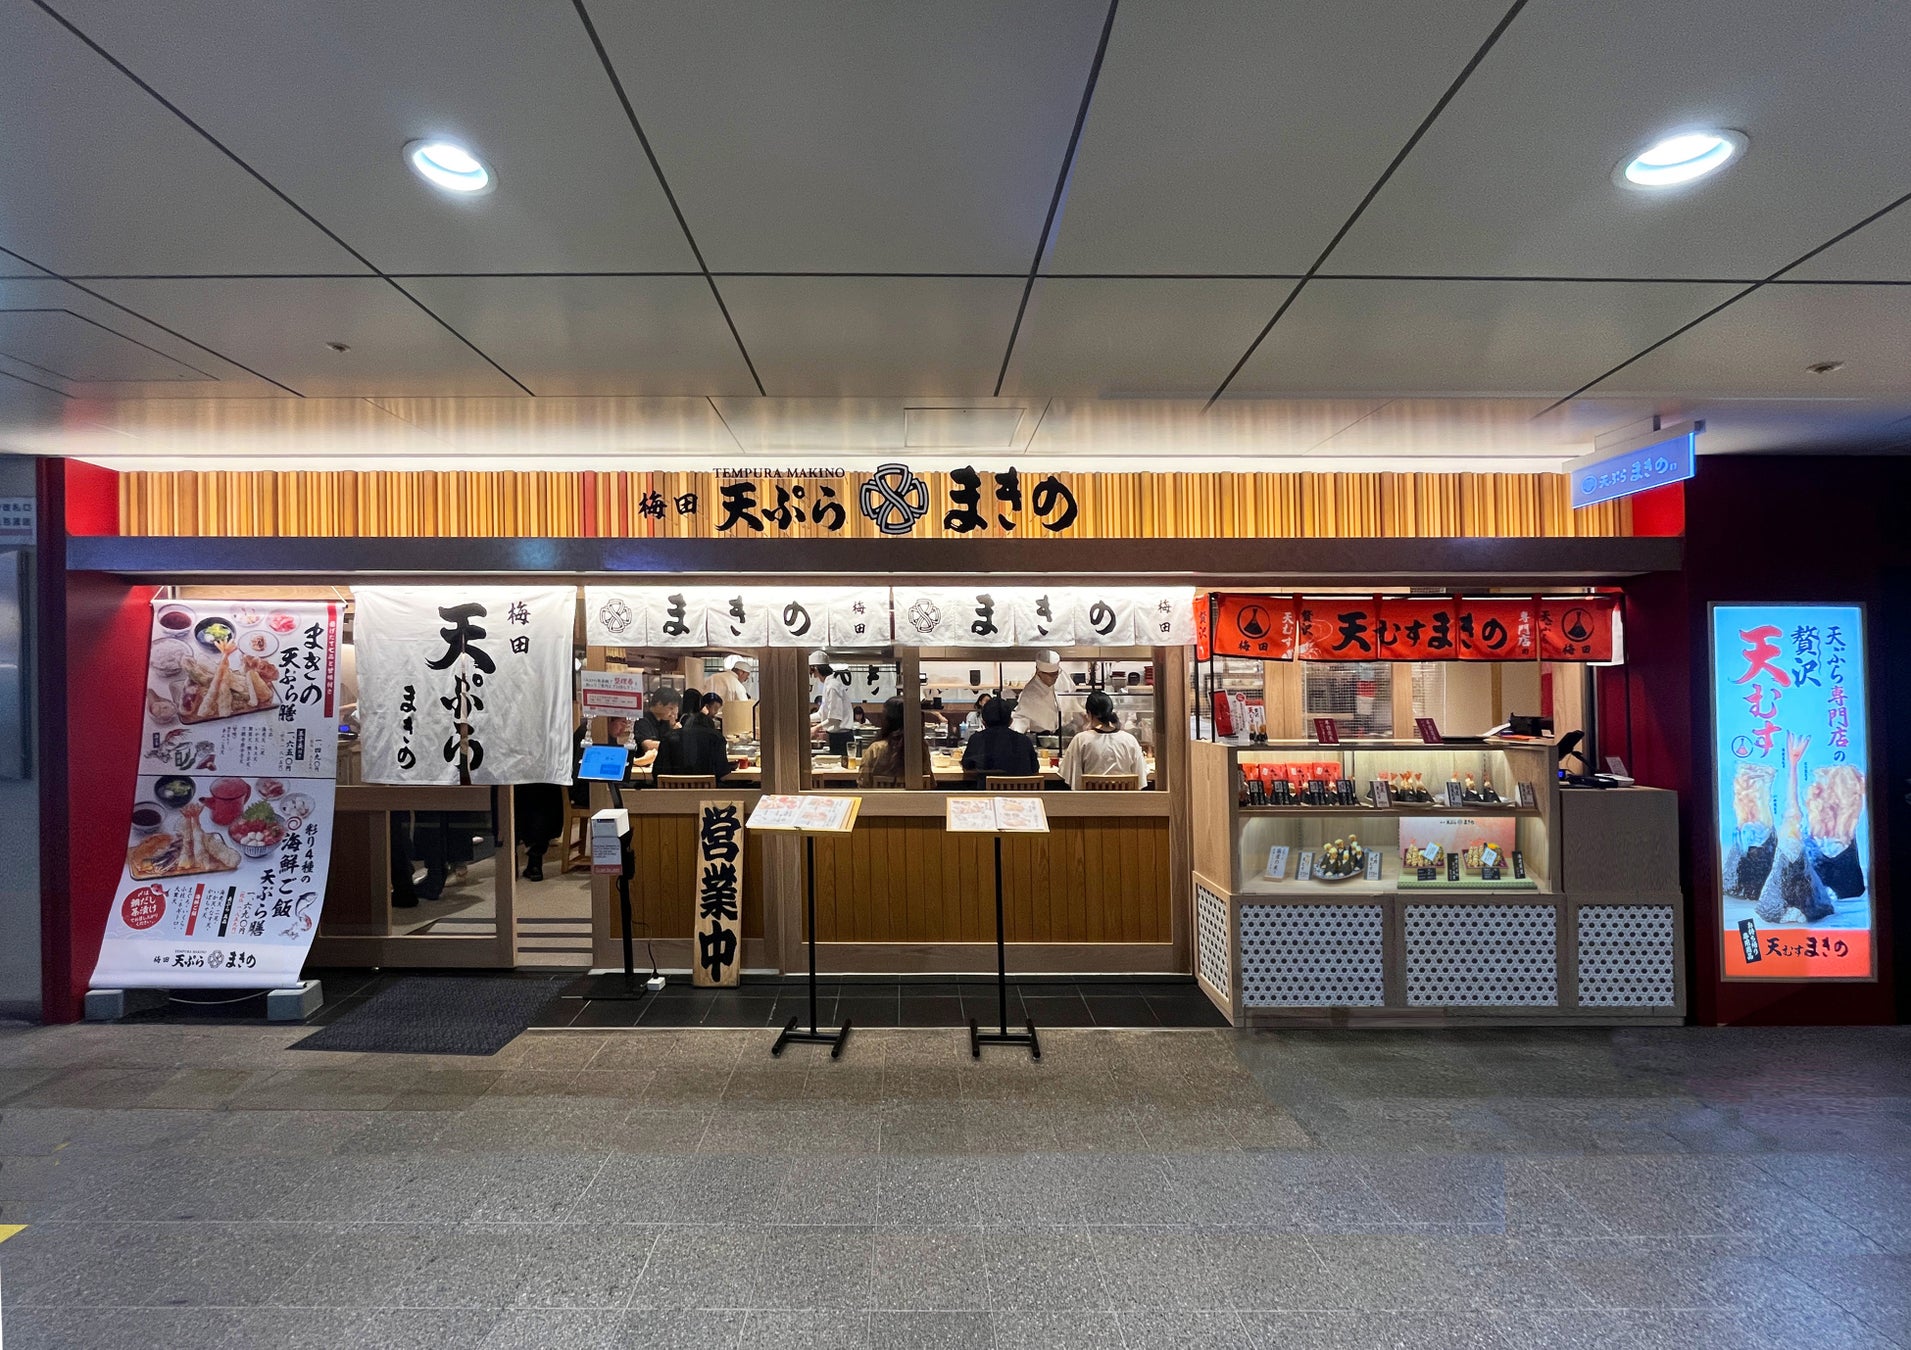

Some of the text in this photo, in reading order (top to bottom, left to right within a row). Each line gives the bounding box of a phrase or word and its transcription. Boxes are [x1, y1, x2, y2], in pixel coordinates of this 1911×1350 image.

[638, 465, 1078, 533] 梅田 天ぷら まきの
[713, 467, 846, 478] TEMPURA MAKINO
[508, 601, 531, 655] 梅田
[663, 593, 869, 637] まきの 梅田
[971, 593, 1172, 637] まきの 梅田
[1239, 640, 1269, 651] 梅田
[300, 622, 324, 705] まきの
[425, 602, 496, 771] 天ぷら
[1791, 625, 1821, 688] 贅沢
[1730, 625, 1791, 758] 天むす
[398, 684, 417, 770] まきの
[272, 832, 302, 918] 海鮮ご飯
[699, 806, 742, 982] 営業中
[172, 954, 204, 968] 天ぷら
[225, 951, 256, 969] まきの
